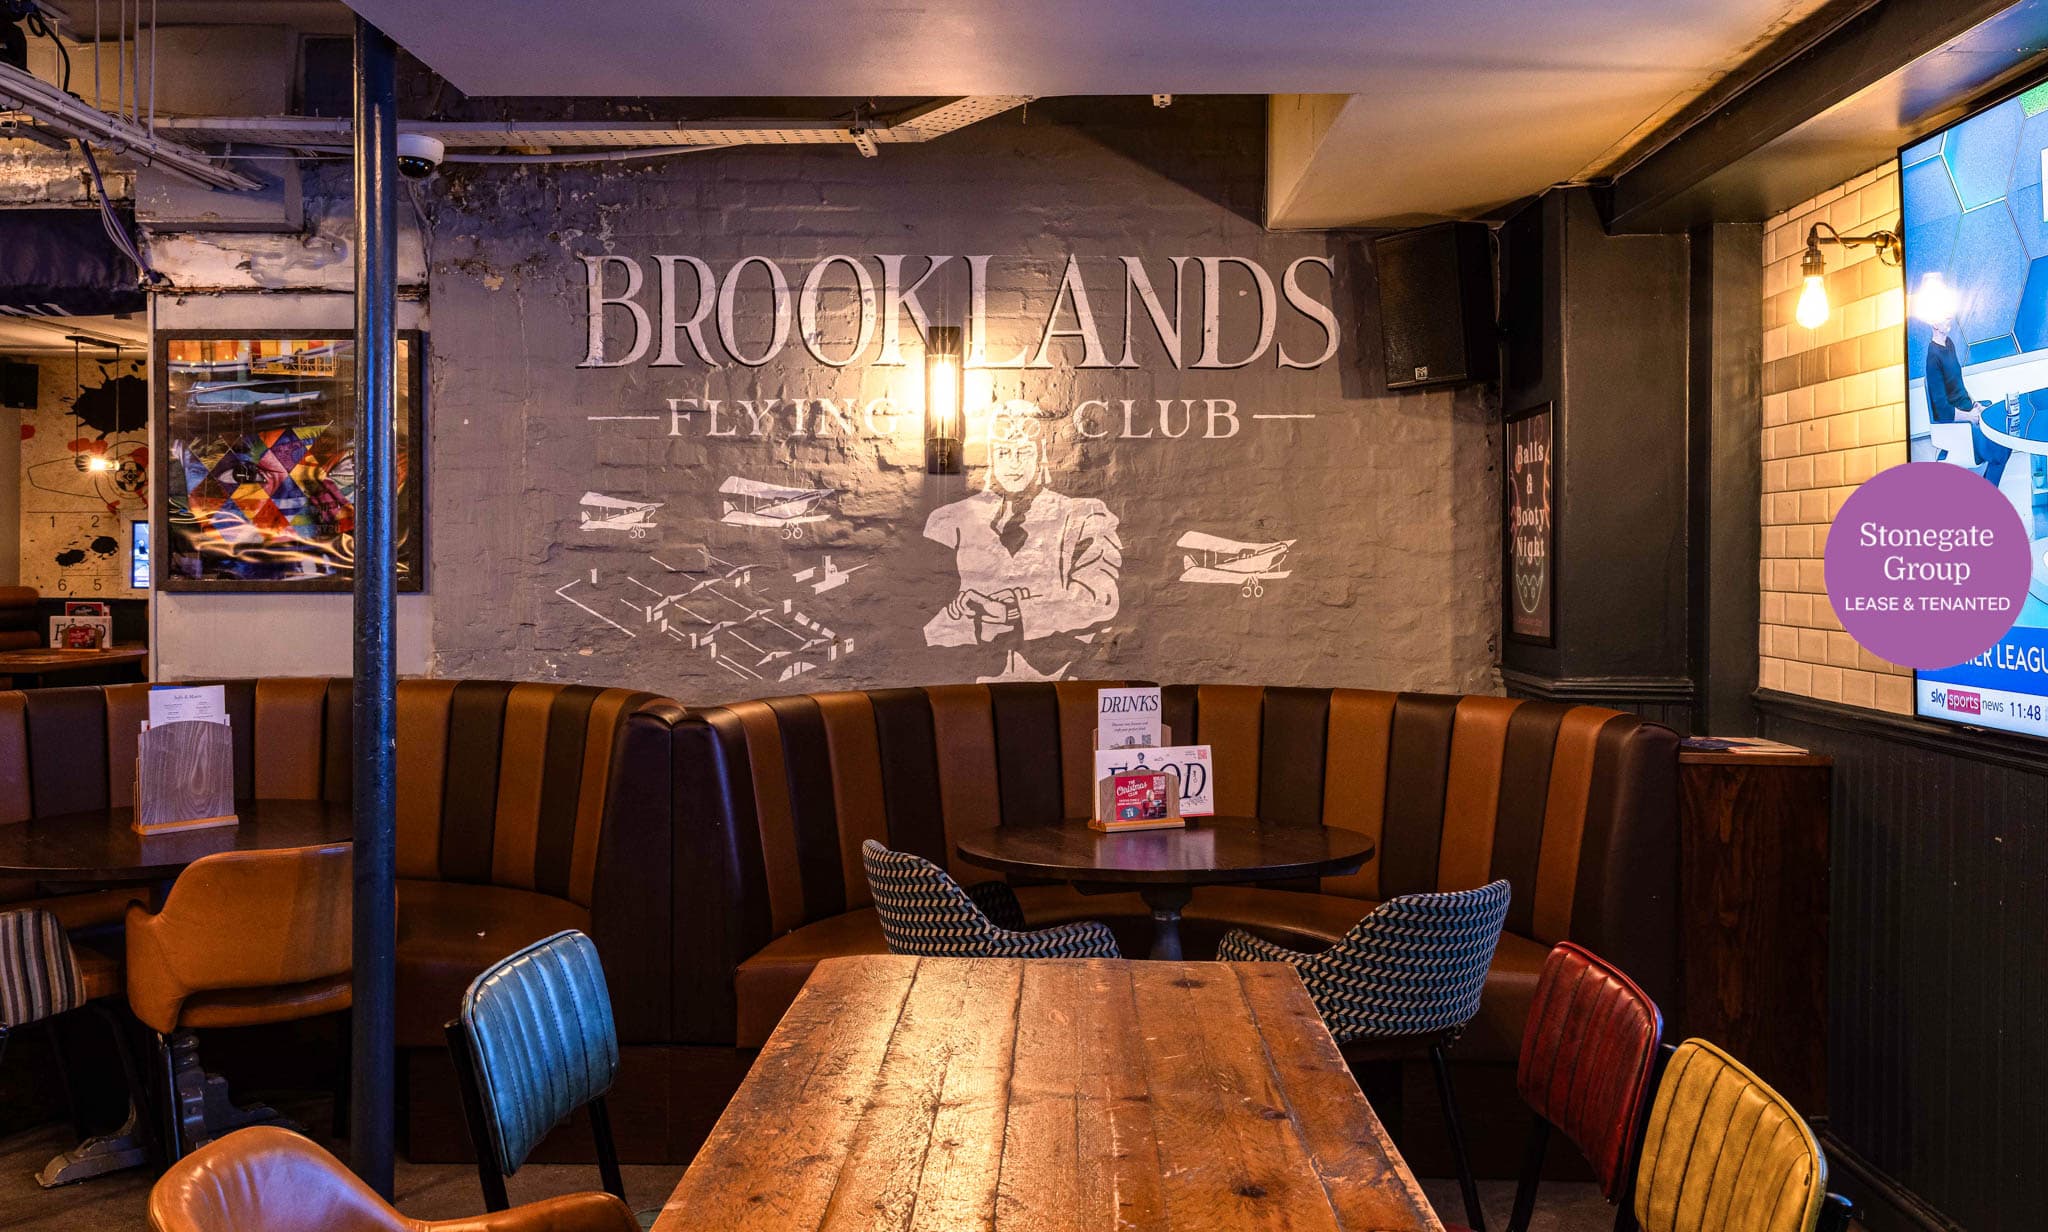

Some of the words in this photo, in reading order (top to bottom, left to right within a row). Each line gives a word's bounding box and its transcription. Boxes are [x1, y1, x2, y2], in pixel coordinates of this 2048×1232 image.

[576, 253, 1342, 370] BROOKLANDS
[666, 397, 904, 437] FLYING
[1072, 398, 1240, 439] CLUB
[1517, 441, 1545, 465] Balls
[91, 515, 100, 528] 2
[1515, 505, 1546, 533] Booty
[1516, 536, 1545, 565] Night
[58, 578, 67, 591] 6
[94, 578, 102, 591] 5
[1100, 694, 1159, 713] DRINKS
[1931, 688, 1946, 708] sky
[1948, 694, 1980, 710] sports
[1982, 699, 2004, 712] news
[2010, 702, 2041, 720] 11:48
[1116, 781, 1148, 796] Christmas
